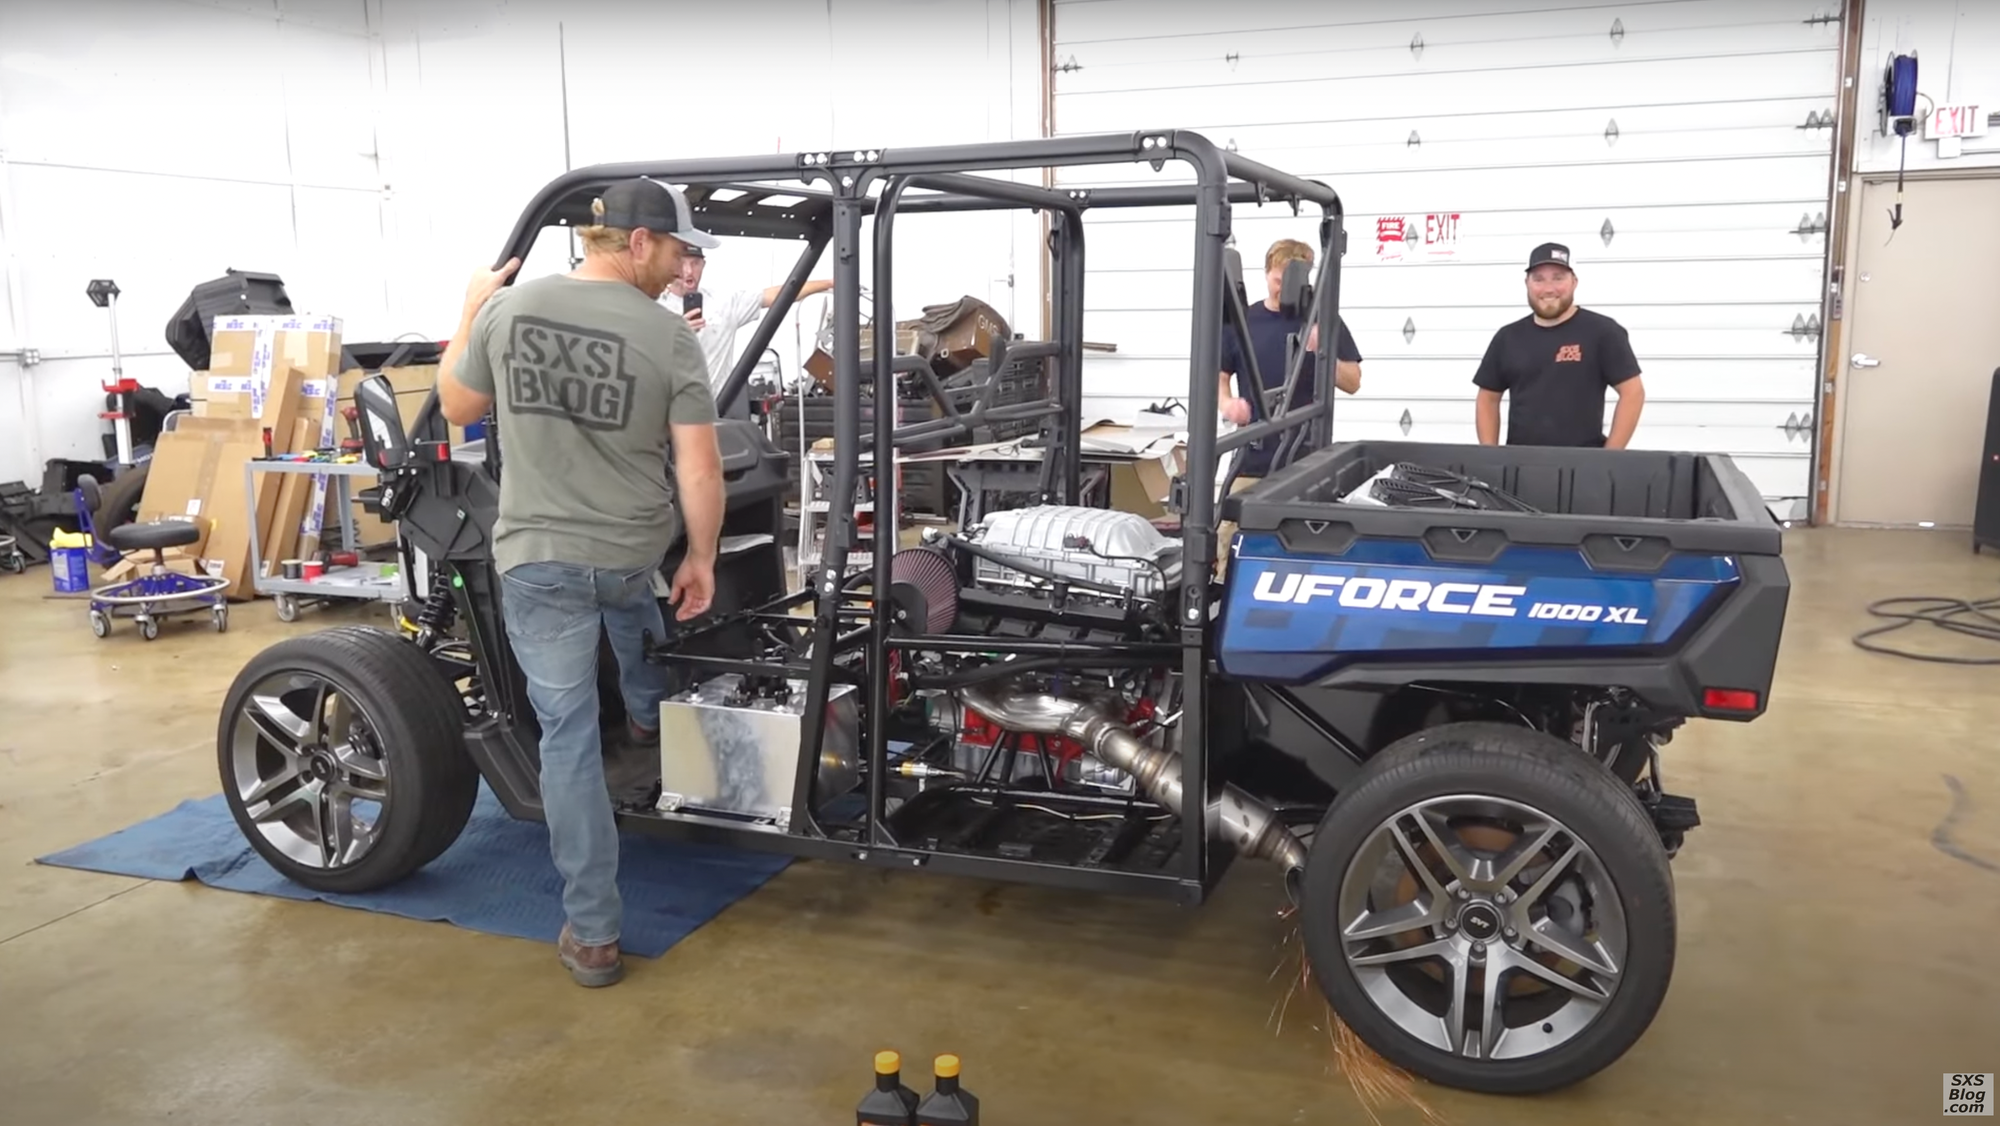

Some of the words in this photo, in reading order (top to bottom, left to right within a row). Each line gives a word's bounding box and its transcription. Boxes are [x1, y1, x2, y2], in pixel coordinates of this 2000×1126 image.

[1935, 105, 1979, 134] EXIT
[1425, 213, 1460, 244] EXIT
[521, 327, 612, 379] SXS
[512, 366, 620, 420] BLOG
[1252, 571, 1527, 617] UFORCE
[1527, 602, 1603, 622] 1000
[1602, 605, 1648, 624] XL
